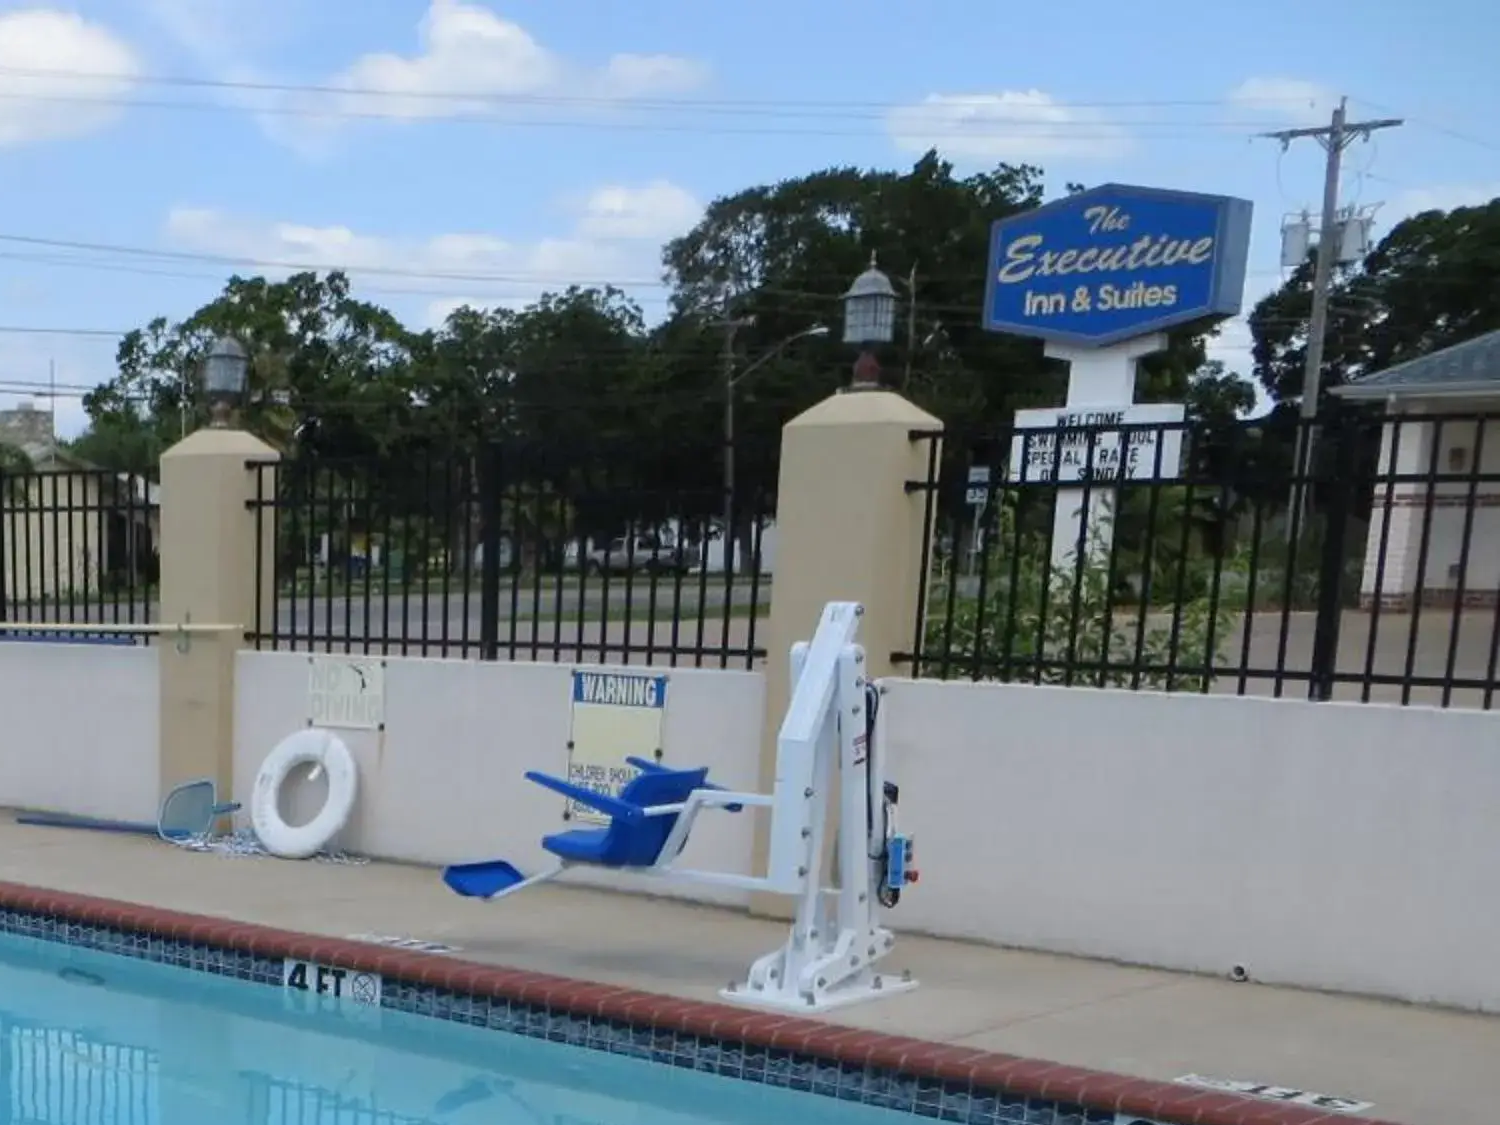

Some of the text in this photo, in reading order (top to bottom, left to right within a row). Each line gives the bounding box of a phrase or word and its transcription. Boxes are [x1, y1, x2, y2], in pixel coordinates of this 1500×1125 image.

[1084, 205, 1131, 235] The
[998, 234, 1213, 282] Executive
[1025, 281, 1178, 316] Inn & Suites
[1057, 412, 1124, 427] WELCOME
[1028, 447, 1139, 465] SPECAL RAE
[1077, 466, 1137, 481] SNDY
[582, 673, 657, 706] WARNING
